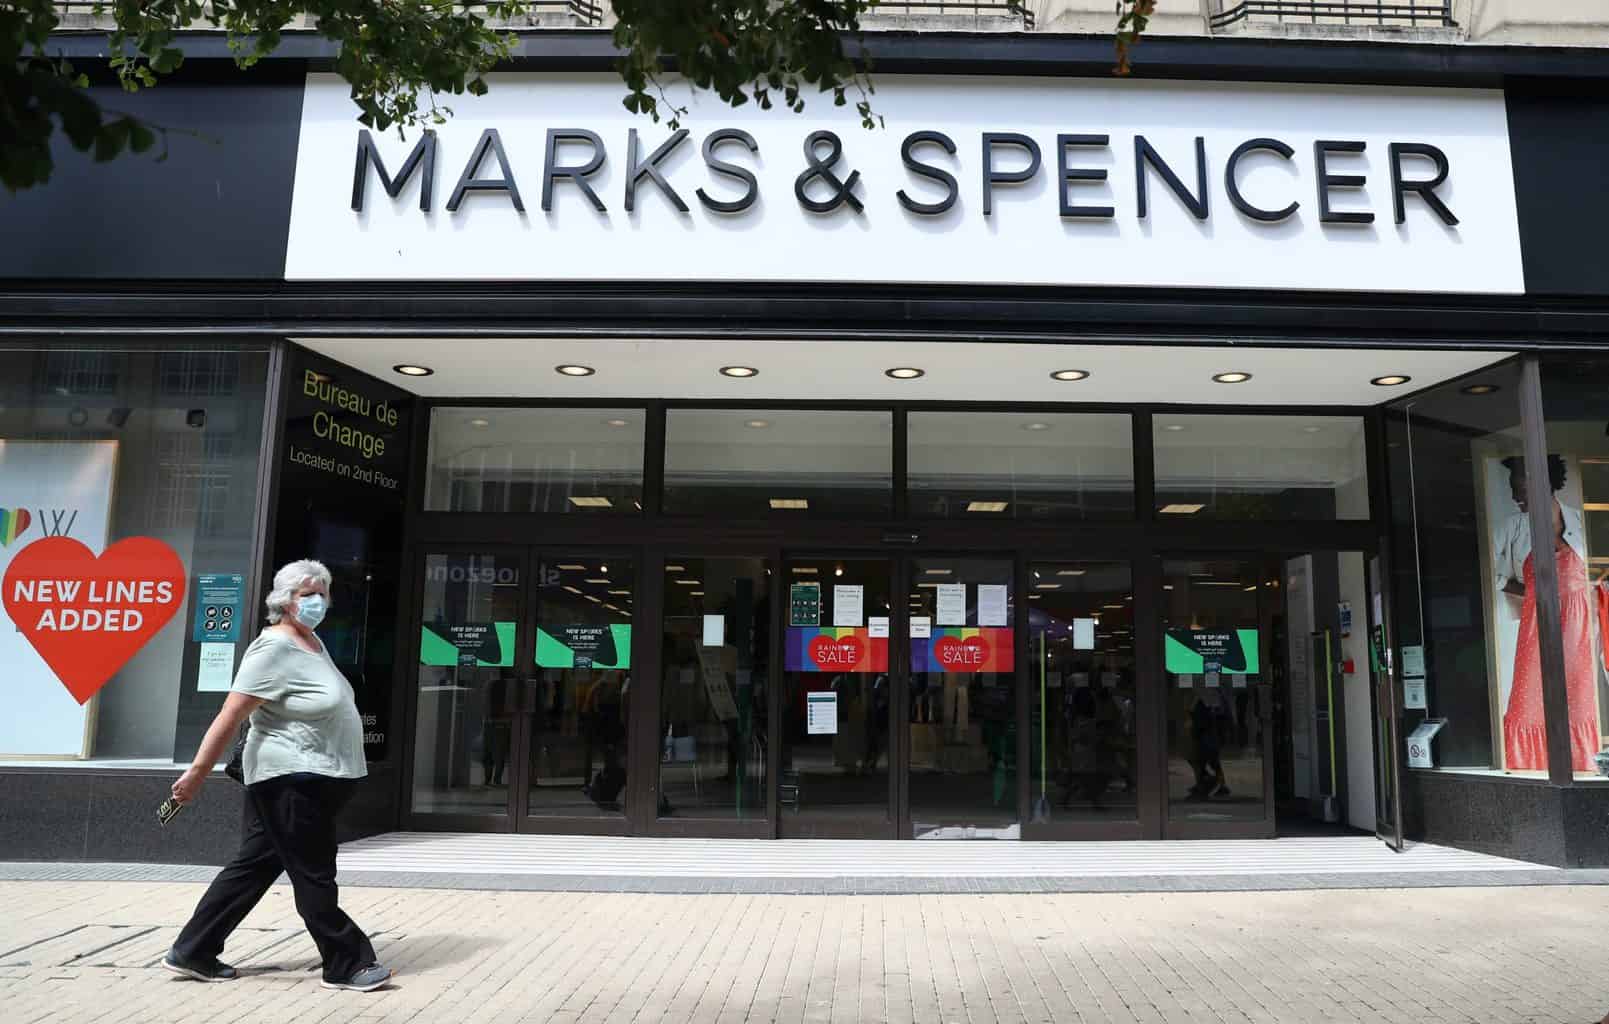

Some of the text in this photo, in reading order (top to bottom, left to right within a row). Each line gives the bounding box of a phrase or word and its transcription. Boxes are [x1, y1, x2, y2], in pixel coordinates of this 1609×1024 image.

[351, 128, 1460, 226] MARKS & SPENCER
[304, 369, 398, 426] Bureau de
[313, 411, 385, 459] Change
[290, 445, 398, 489] Located on 2nd Floor
[14, 580, 82, 603] NEW
[88, 580, 174, 604] LINES
[36, 608, 144, 632] ADDED
[817, 651, 856, 663] SALE
[943, 651, 982, 664] SALE
